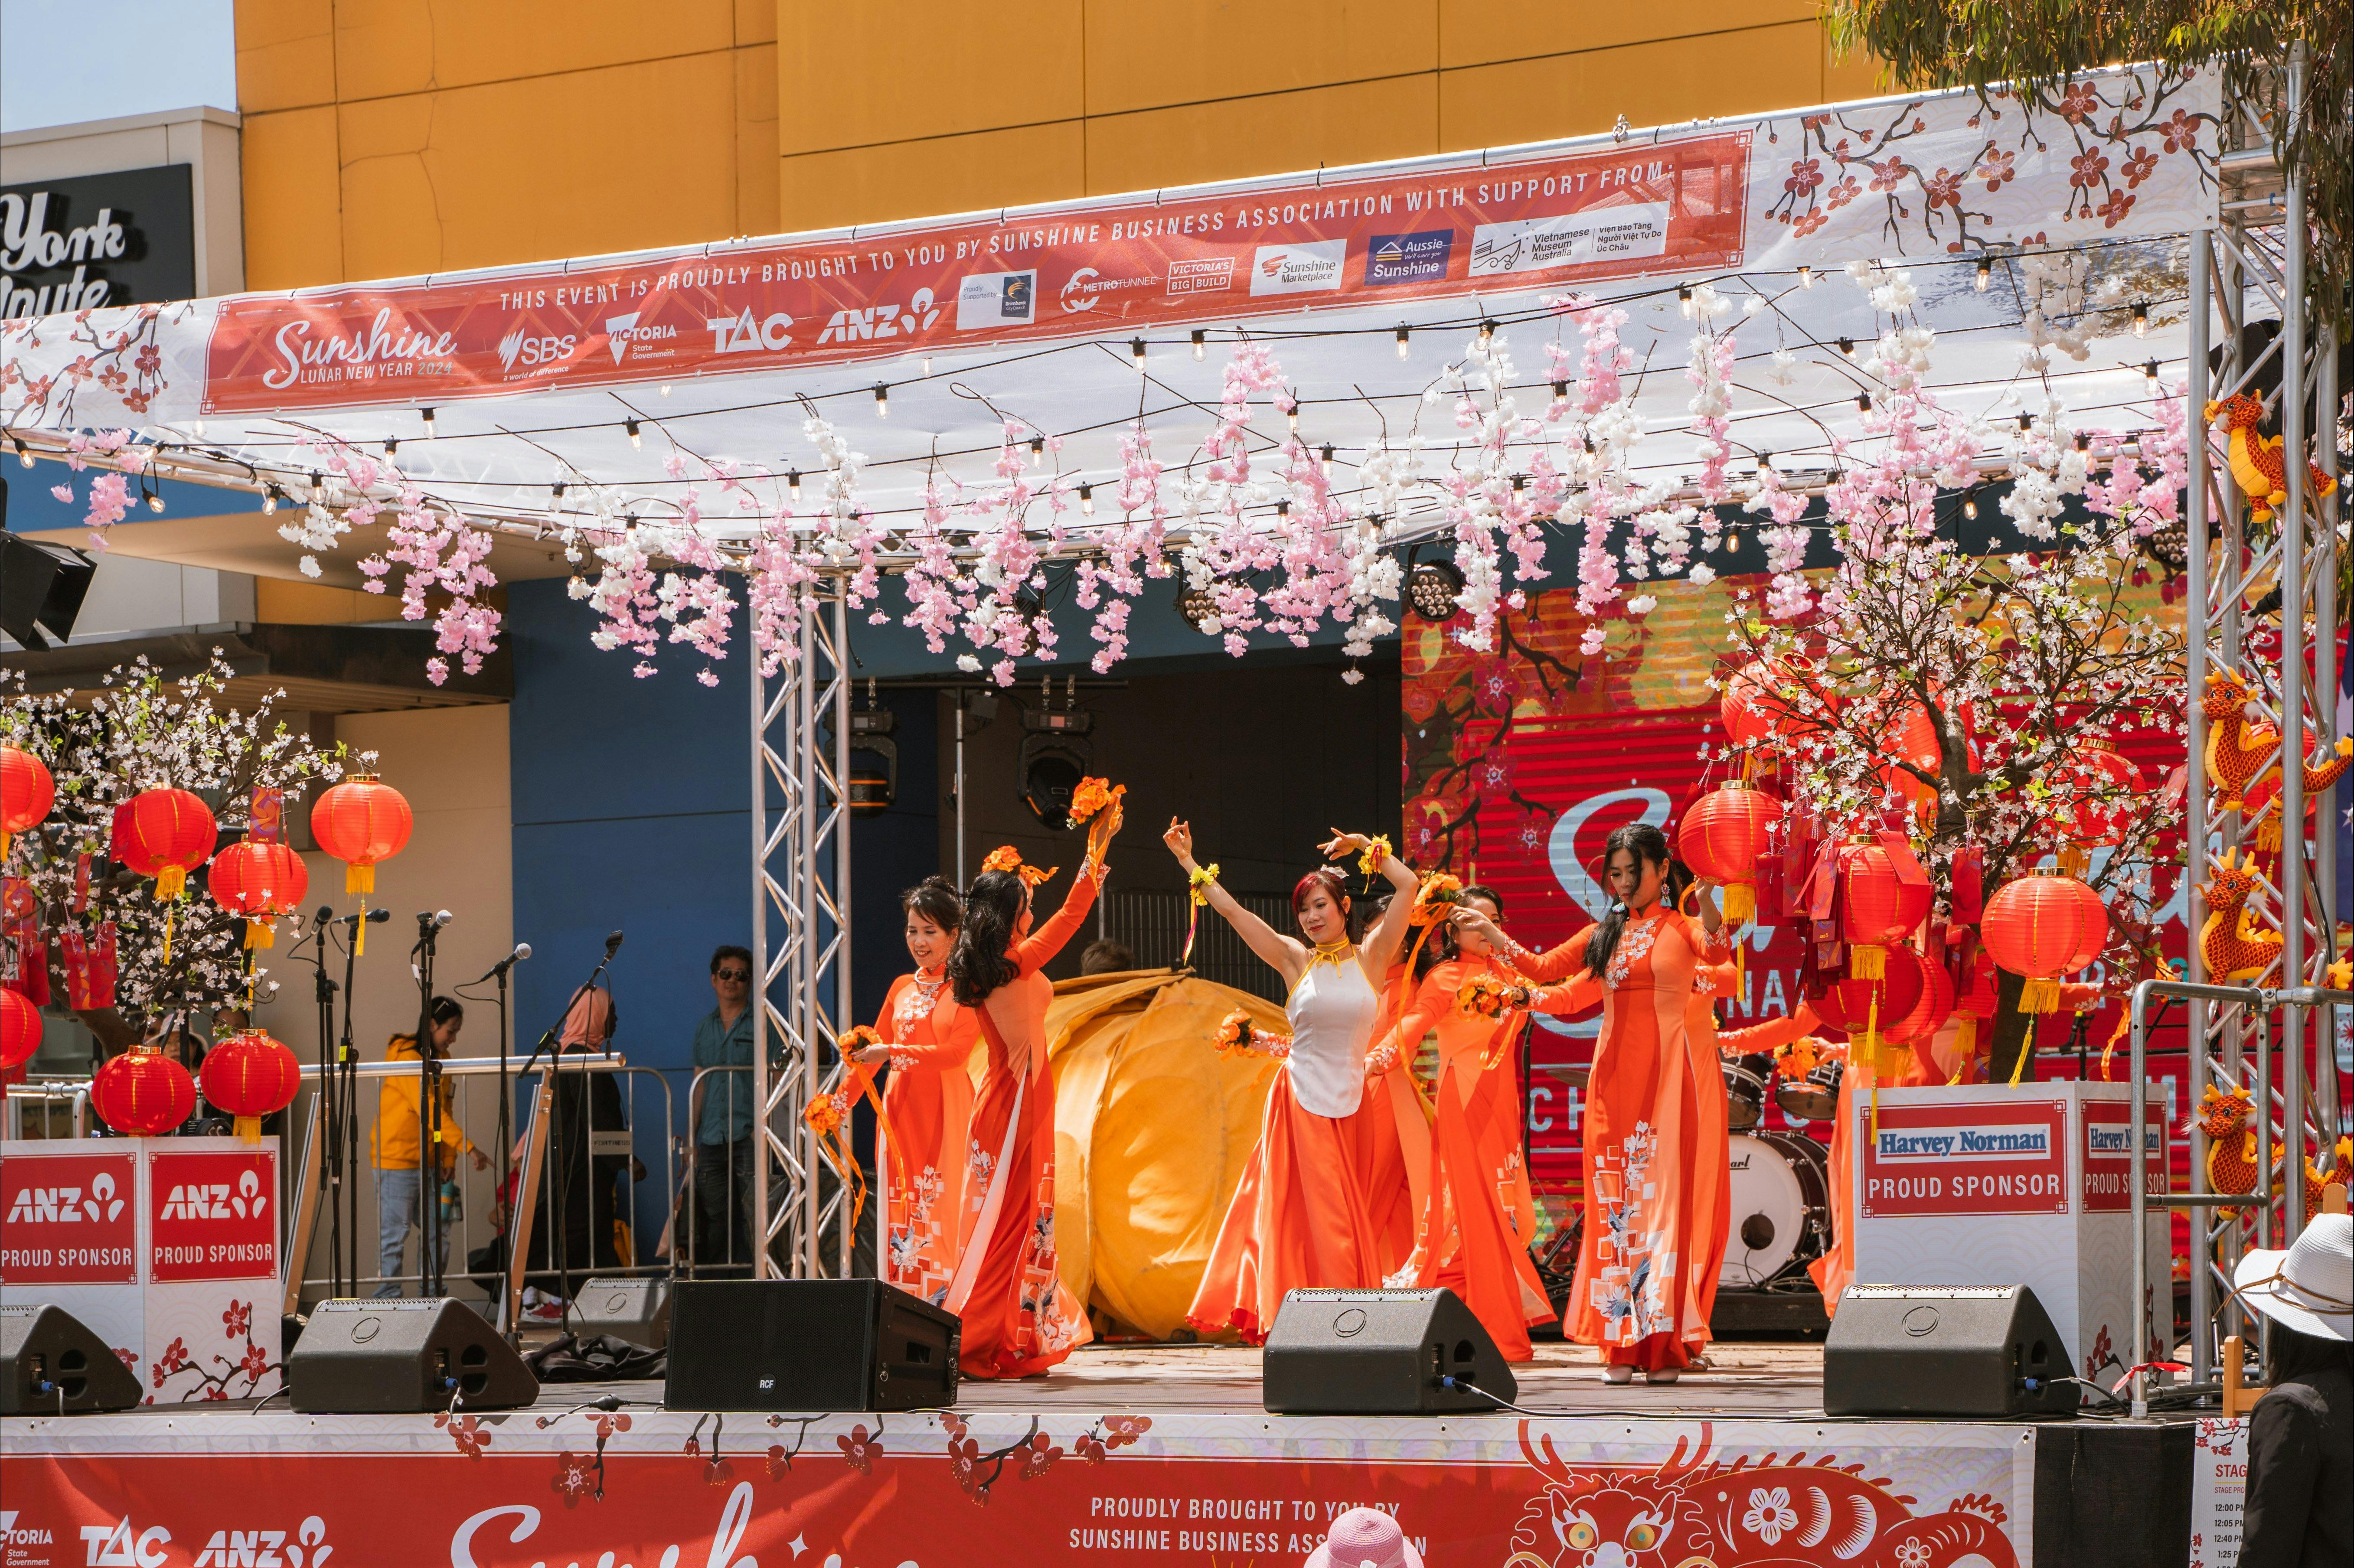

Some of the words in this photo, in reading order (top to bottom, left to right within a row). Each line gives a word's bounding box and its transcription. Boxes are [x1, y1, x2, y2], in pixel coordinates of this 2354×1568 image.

[0, 192, 125, 271] York
[501, 290, 545, 310] THIS
[556, 283, 619, 306] EVENT
[630, 279, 648, 298] IS
[656, 264, 751, 292] PROUDLY
[762, 255, 857, 282] BROUGHT
[868, 251, 894, 271] TO
[904, 244, 945, 267] YOU
[956, 239, 980, 260] BY
[989, 225, 1099, 254] SUNSHINE
[1111, 212, 1224, 241] BUSINESS
[1236, 194, 1392, 229] ASSOCIATION
[1406, 185, 1464, 212] WITH
[1478, 173, 1588, 205] SUPPORT
[1600, 161, 1674, 189] FROM:
[1535, 229, 1590, 243] Vietnamese
[1598, 234, 1621, 244] Người
[1405, 239, 1443, 252] Aussie
[1531, 248, 1572, 261] Australia
[1532, 241, 1572, 252] Museum
[1597, 244, 1607, 252] Úc
[1282, 260, 1336, 274] Sunshine
[1374, 261, 1439, 277] Sunshine
[1083, 276, 1156, 293] METROTUNNEL
[1171, 277, 1190, 291] BIG
[1195, 275, 1227, 288] BUILD
[1281, 271, 1333, 285] Marketplace
[963, 292, 990, 300] Supported
[706, 305, 794, 353] TAC
[817, 304, 900, 344] ANZ
[608, 325, 677, 342] VICTORIA
[263, 307, 457, 389] Sunshine
[521, 335, 576, 365] SBS
[632, 349, 675, 360] Government
[300, 366, 341, 384] LUNAR
[346, 364, 375, 380] NEW
[380, 362, 412, 377] YEAR
[417, 362, 452, 376] 2024
[509, 372, 528, 381] world
[529, 370, 537, 378] of
[537, 366, 569, 377] difference
[1880, 1129, 1955, 1156] Harvey
[1960, 1131, 2046, 1152] Norman
[2090, 1128, 2124, 1153] Harvey
[2125, 1128, 2159, 1148] Nan
[1730, 1154, 1750, 1167] arl
[1869, 1177, 1942, 1199] PROUD
[1952, 1174, 2060, 1197] SPONSOR
[2086, 1173, 2119, 1194] PROUD
[2123, 1173, 2165, 1193] SSOR
[7, 1187, 82, 1223] ANZ
[160, 1184, 231, 1220] ANZ
[1, 1249, 52, 1267] PROUD
[58, 1247, 131, 1266] SPONSOR
[155, 1245, 203, 1265] PROUD
[209, 1243, 272, 1263] SPONSOR
[760, 1379, 774, 1389] RCF
[2215, 1464, 2247, 1477] STAG
[1091, 1497, 1180, 1518] PROUDLY
[1188, 1499, 1283, 1520] BROUGHT
[1292, 1501, 1316, 1521] TO
[0, 1529, 53, 1545] CTORIA
[80, 1514, 172, 1568] TAC
[1069, 1529, 1170, 1550] SUNSHINE
[1178, 1531, 1279, 1554] BUSINESS
[193, 1530, 287, 1568] ANZ
